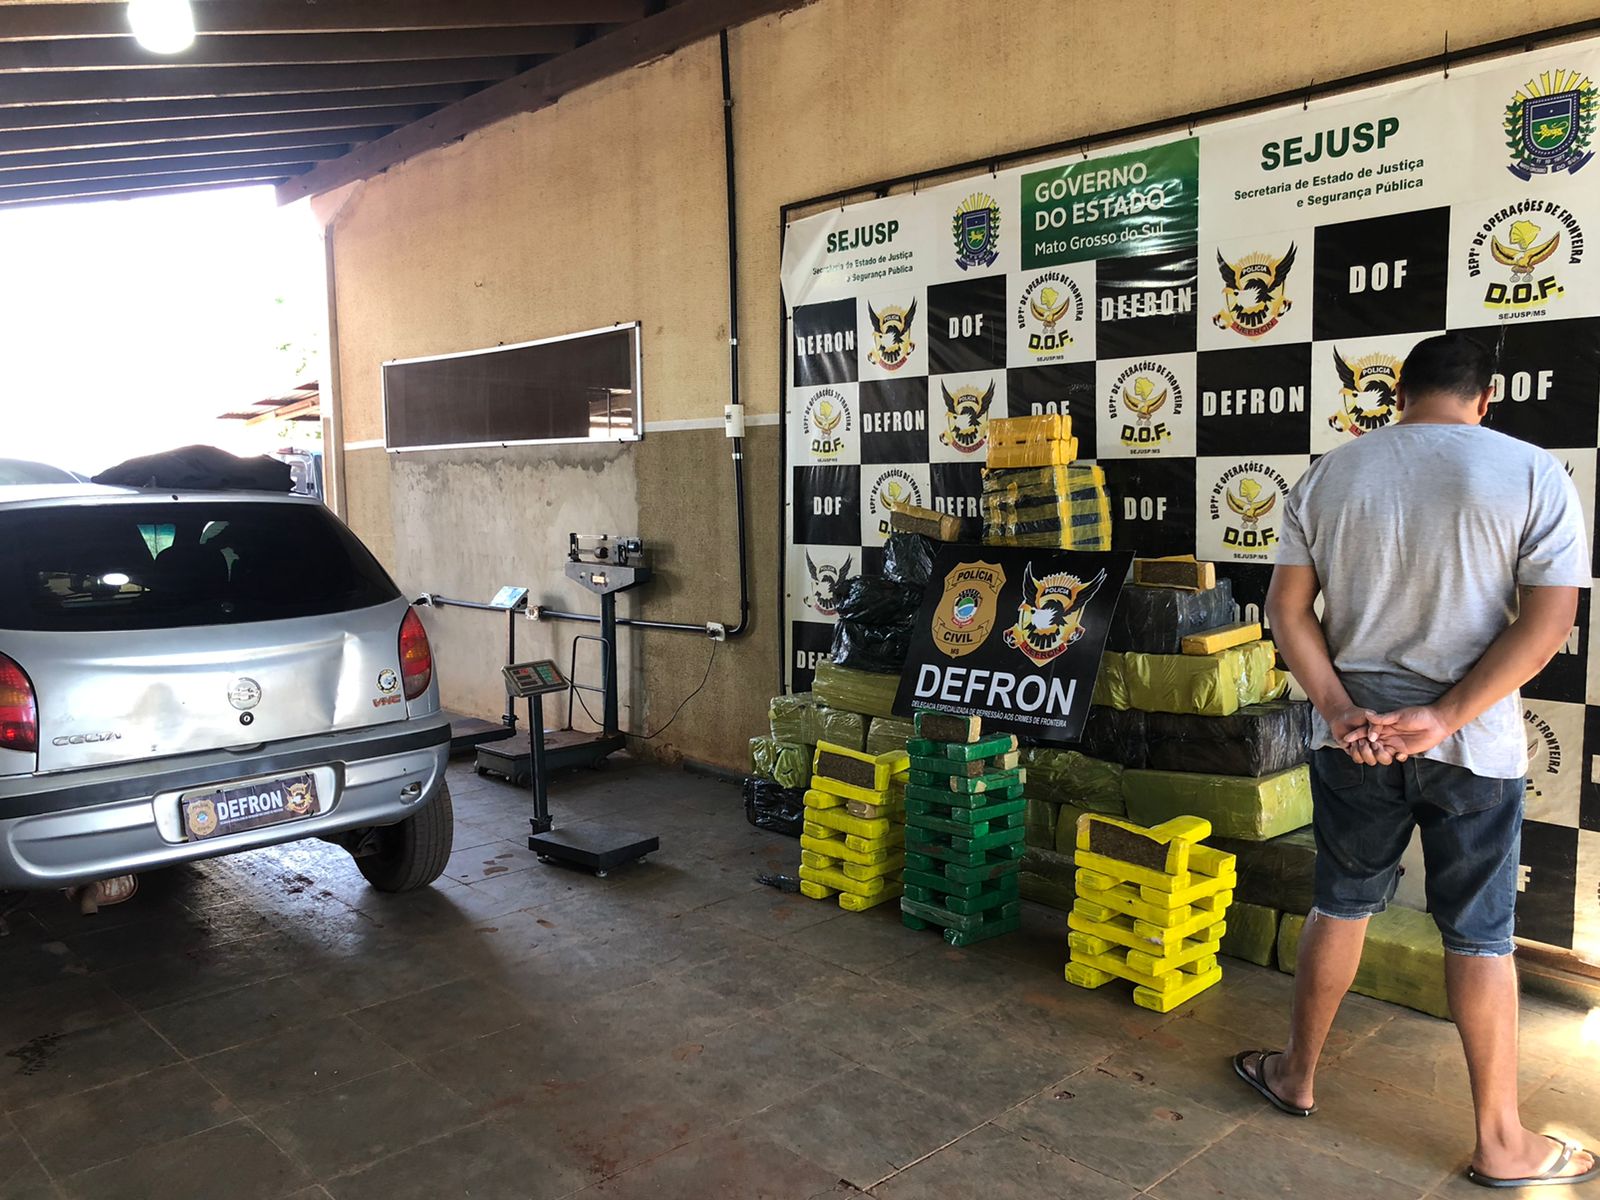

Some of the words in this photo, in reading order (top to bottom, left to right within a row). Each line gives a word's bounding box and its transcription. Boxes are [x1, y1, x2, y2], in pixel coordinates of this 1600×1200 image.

[1261, 117, 1399, 171] SEJUSP
[1035, 162, 1147, 203] GOVERNO
[1234, 183, 1291, 200] Secretaria
[1295, 180, 1309, 190] de
[1313, 171, 1354, 187] Estado
[1357, 168, 1372, 179] de
[1376, 159, 1424, 175] Justiça
[1296, 199, 1304, 207] e
[1307, 188, 1371, 207] Segurança
[1376, 178, 1423, 195] Pública
[1035, 207, 1066, 231] DO
[1072, 187, 1165, 225] ESTADO
[827, 220, 899, 253] SEJUSP
[1035, 240, 1067, 256] Mato
[1070, 232, 1117, 250] Grosso
[1120, 227, 1138, 241] do
[1141, 222, 1164, 239] Sul
[1473, 231, 1488, 246] DE
[1483, 198, 1544, 232] OPERAÇÕES
[1544, 201, 1560, 216] DE
[1557, 209, 1584, 265] FRONTEIRA
[854, 257, 877, 268] Estado
[888, 250, 913, 263] Justiça
[852, 270, 886, 283] Segurança
[1348, 259, 1408, 294] DOF
[1484, 275, 1564, 304] D.O.F.
[1101, 286, 1192, 321] DEFRON
[949, 313, 983, 339] DOF
[1028, 330, 1073, 350] D.O.F.
[797, 330, 854, 356] DEFRON
[1111, 383, 1121, 394] DE
[1117, 360, 1156, 383] OPERAÇÕES
[1156, 364, 1167, 376] DE
[1165, 371, 1182, 415] FRONTEIRA
[1202, 386, 1304, 416] DEFRON
[1490, 370, 1554, 403] DOF
[863, 410, 925, 433] DEFRON
[1121, 422, 1171, 442] D.O.F.
[1213, 483, 1224, 494] DE
[1220, 460, 1264, 484] OPERAÇÕES
[1264, 466, 1276, 478] DE
[813, 497, 842, 516] DOF
[1124, 497, 1167, 520] DOF
[944, 632, 973, 643] CIVIL
[914, 663, 1077, 716] DEFRON
[1033, 716, 1040, 725] DE
[1523, 710, 1538, 724] DE
[1536, 720, 1561, 774] FRONTEIRA
[216, 790, 283, 820] DEFRON
